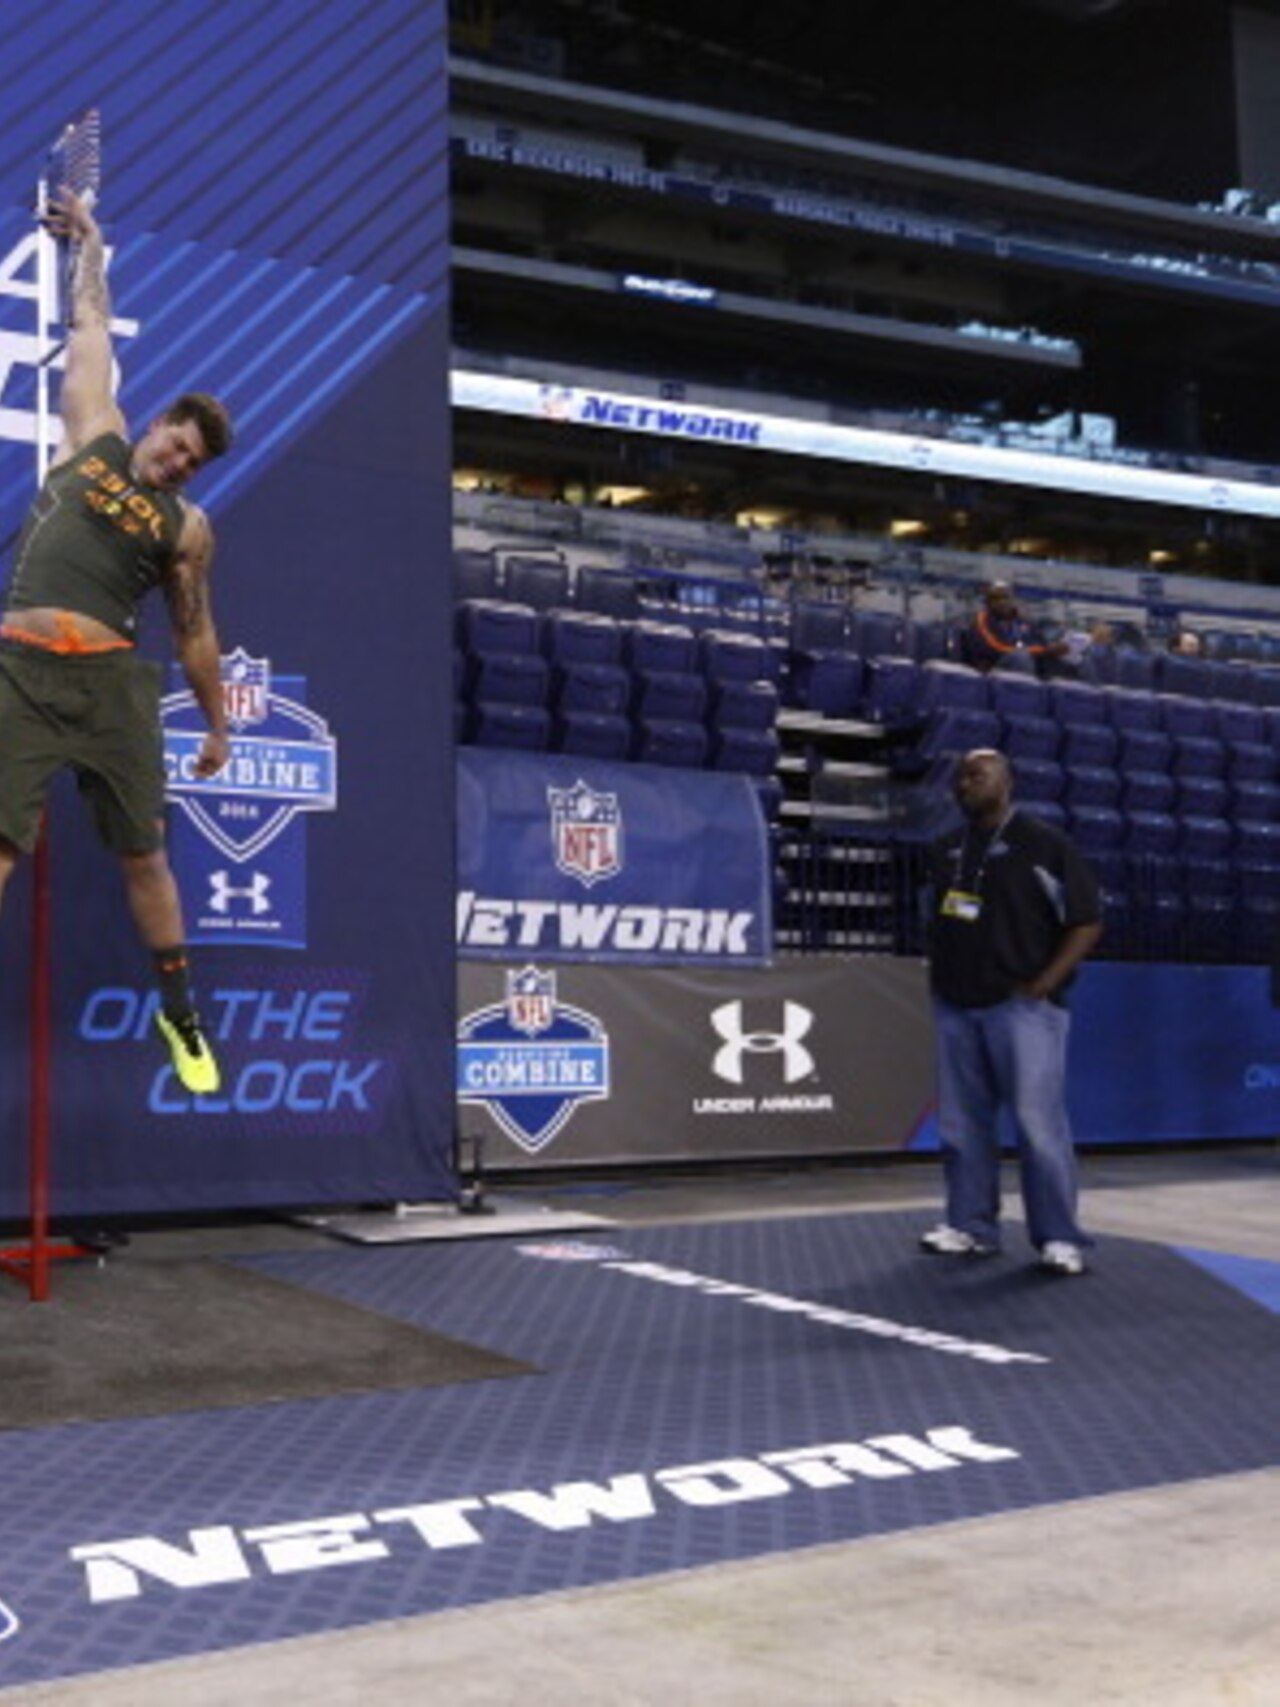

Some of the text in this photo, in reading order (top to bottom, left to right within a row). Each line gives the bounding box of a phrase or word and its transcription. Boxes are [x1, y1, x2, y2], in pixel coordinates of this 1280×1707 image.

[581, 396, 762, 442] NETWORK
[564, 826, 614, 871] NFL
[213, 990, 350, 1041] THE
[516, 998, 547, 1026] NFL
[465, 1058, 597, 1087] COMBINE
[692, 1097, 756, 1114] UNDER
[70, 1425, 1022, 1604] NETWORK
